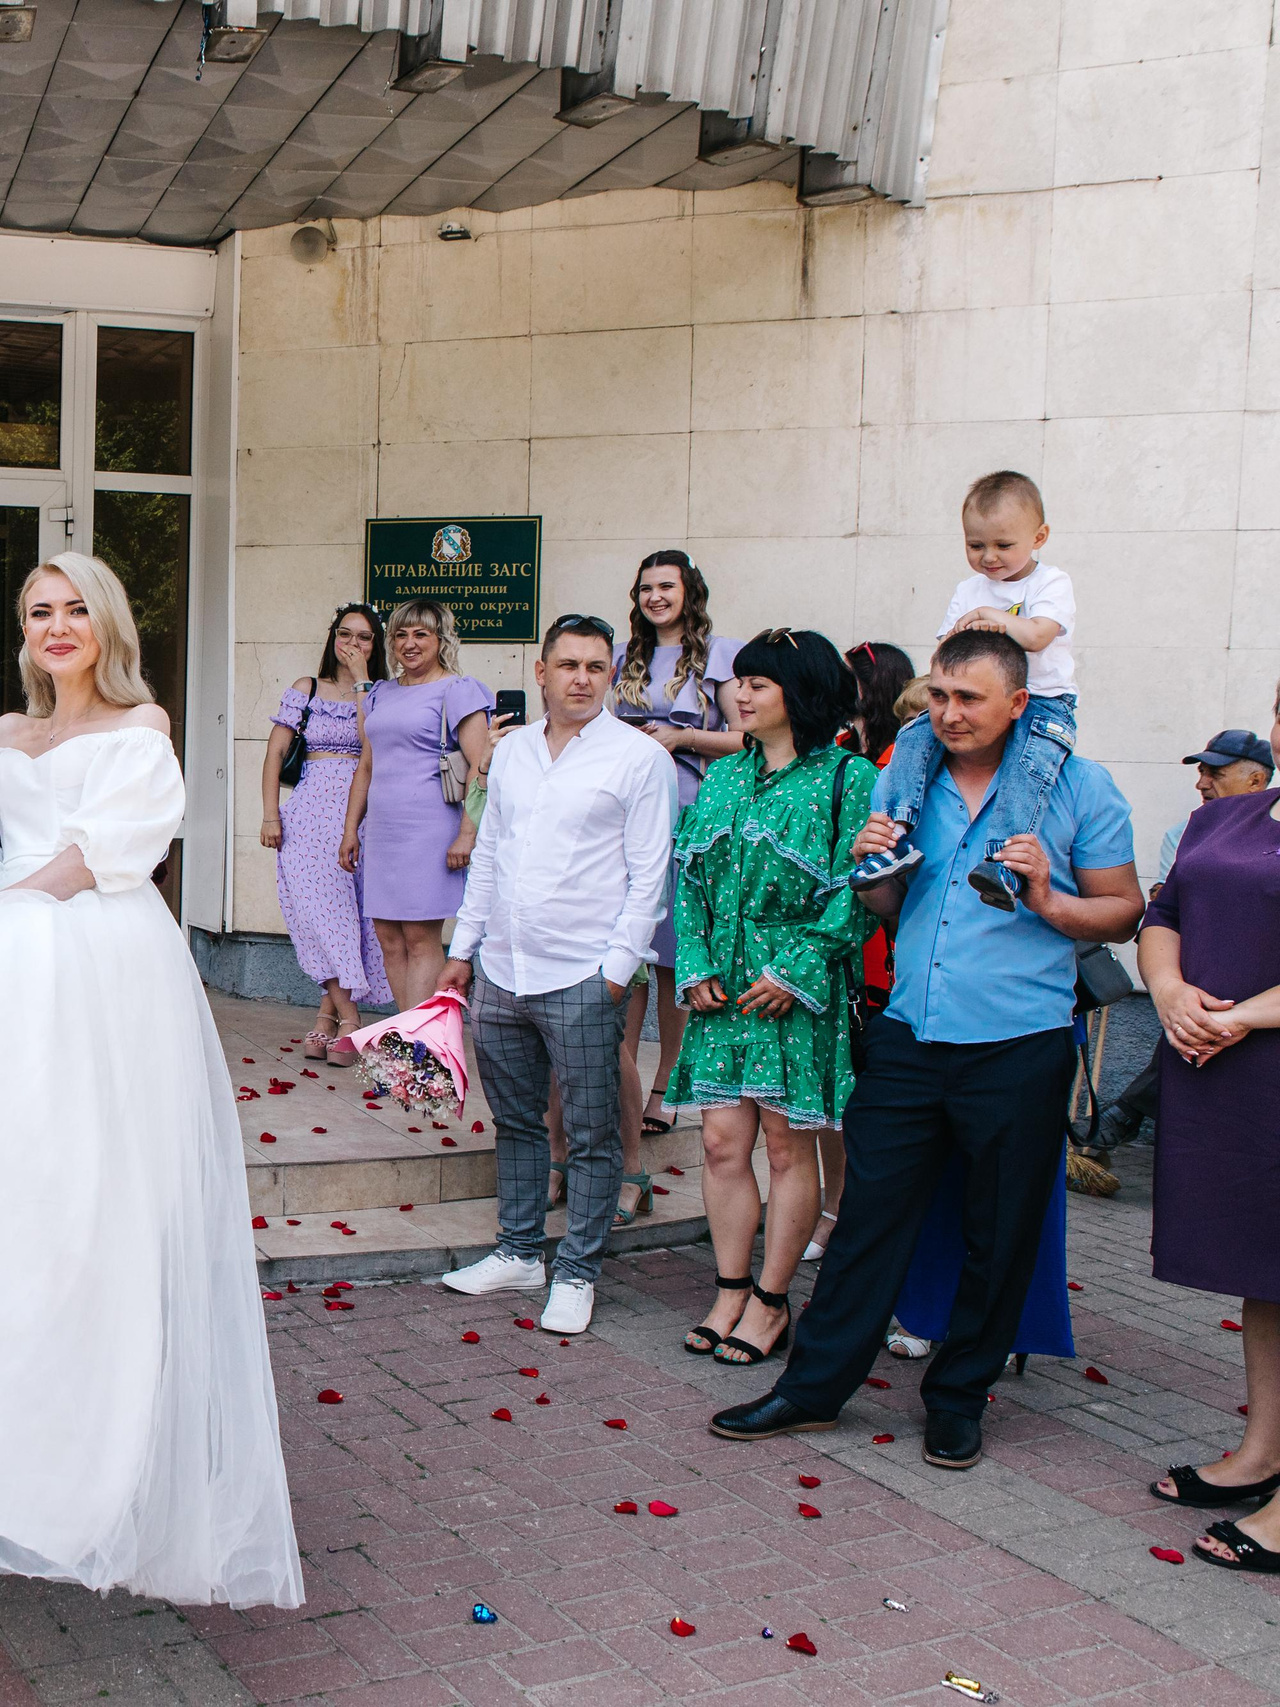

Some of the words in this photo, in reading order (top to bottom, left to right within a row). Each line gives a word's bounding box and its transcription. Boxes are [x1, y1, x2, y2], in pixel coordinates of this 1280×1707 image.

[374, 564, 482, 578] УПРАВЛЕНИЕ
[490, 563, 532, 577] ЗАГС
[395, 585, 507, 597] администрации
[480, 602, 529, 614] округа
[452, 616, 503, 628] Курска
